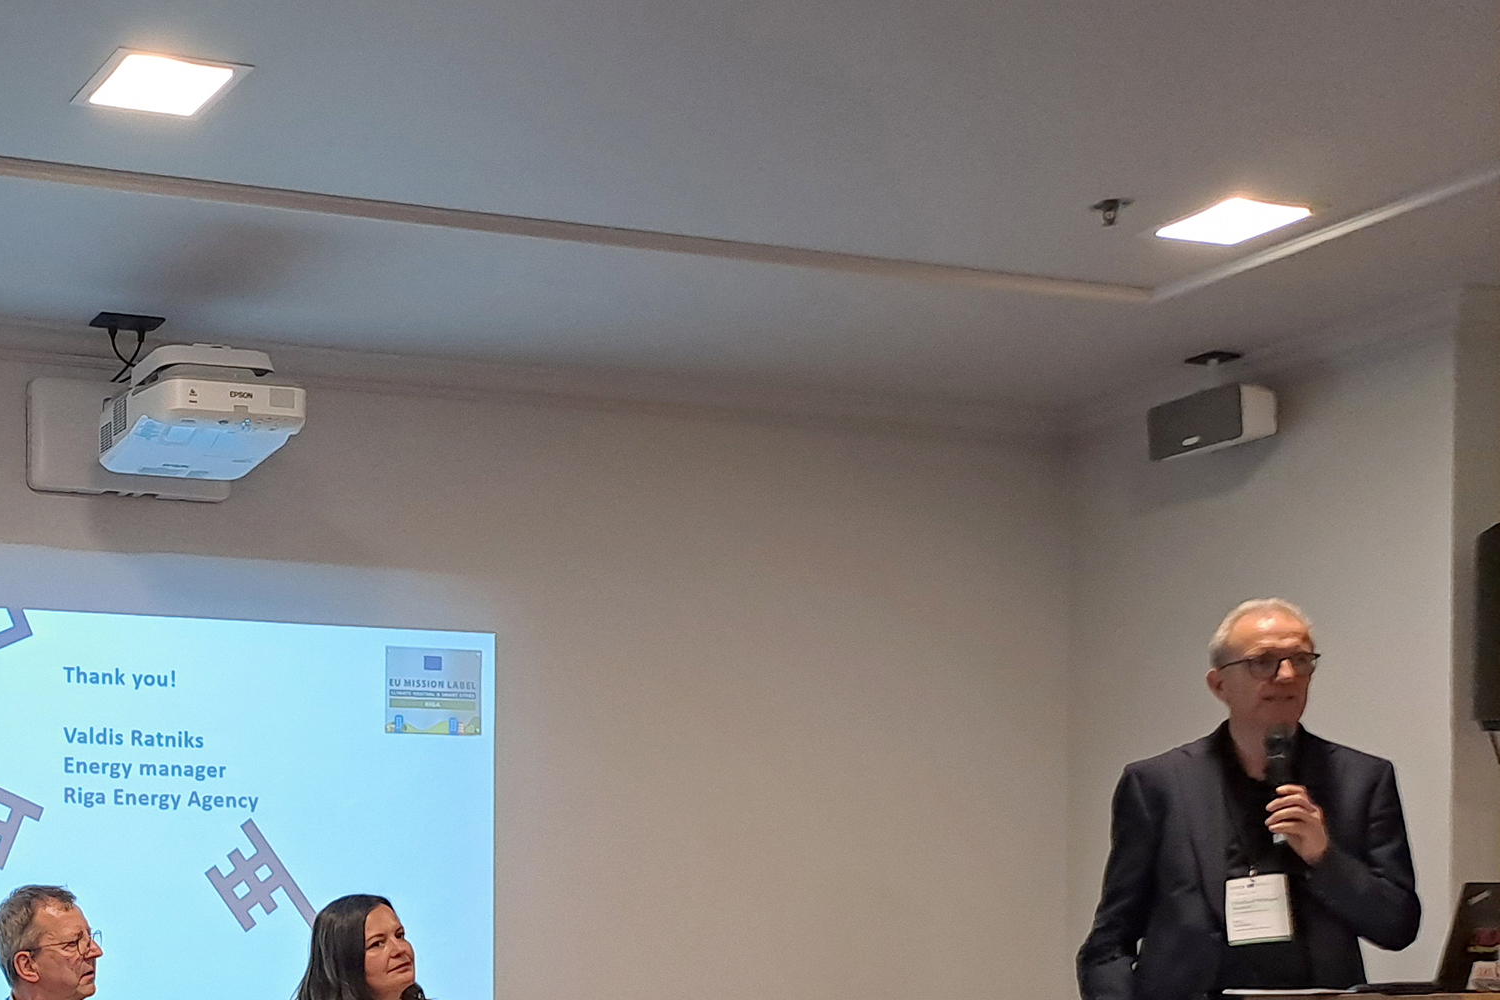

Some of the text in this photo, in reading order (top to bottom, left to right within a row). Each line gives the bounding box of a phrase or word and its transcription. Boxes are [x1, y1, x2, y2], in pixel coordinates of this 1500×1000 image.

[229, 390, 253, 399] EPSON
[62, 665, 176, 691] Thank you!
[388, 678, 476, 690] EU MISSION LABEL
[63, 726, 204, 749] Valdis Ratniks
[63, 756, 227, 782] Energy manager
[63, 786, 259, 813] Riga Energy Agency
